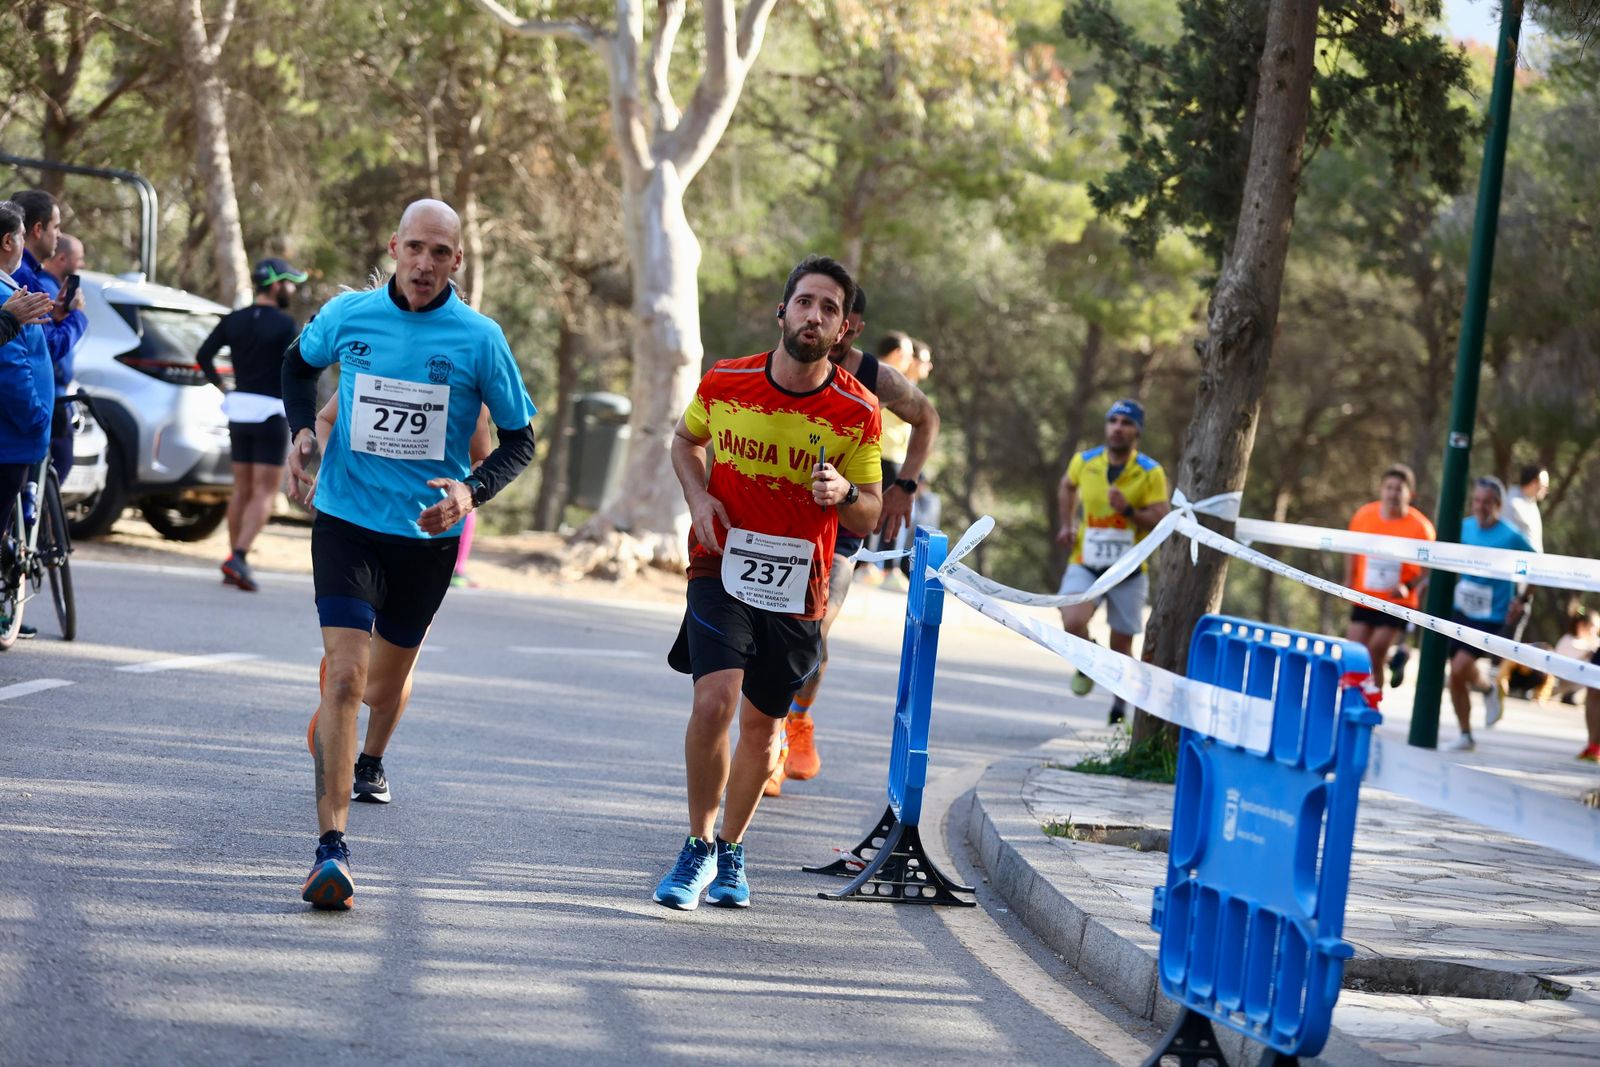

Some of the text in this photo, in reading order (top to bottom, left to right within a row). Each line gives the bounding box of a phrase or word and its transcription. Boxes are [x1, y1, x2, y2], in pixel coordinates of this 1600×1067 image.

[345, 355, 371, 367] HYUNDAI
[373, 407, 427, 435] 279
[380, 446, 394, 454] PEÑA
[740, 559, 793, 588] 237
